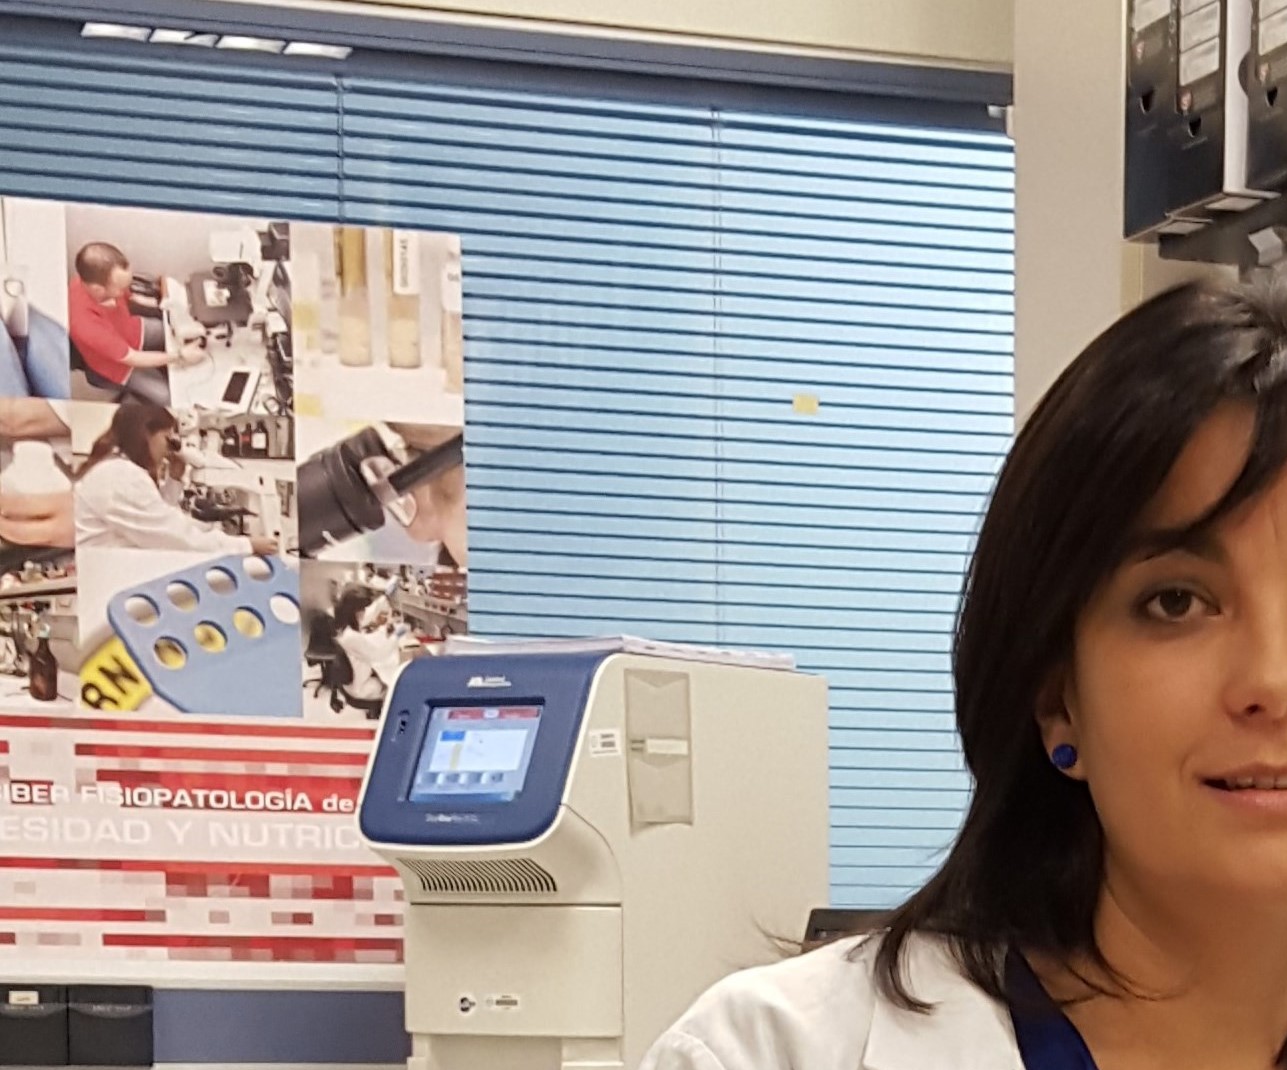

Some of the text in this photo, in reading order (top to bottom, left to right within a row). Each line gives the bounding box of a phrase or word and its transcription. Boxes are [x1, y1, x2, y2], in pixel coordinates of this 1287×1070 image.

[0, 782, 355, 812] IBER FISIOPATOLOGÍA de
[2, 815, 151, 845] ESIDAD
[166, 820, 193, 846] Y
